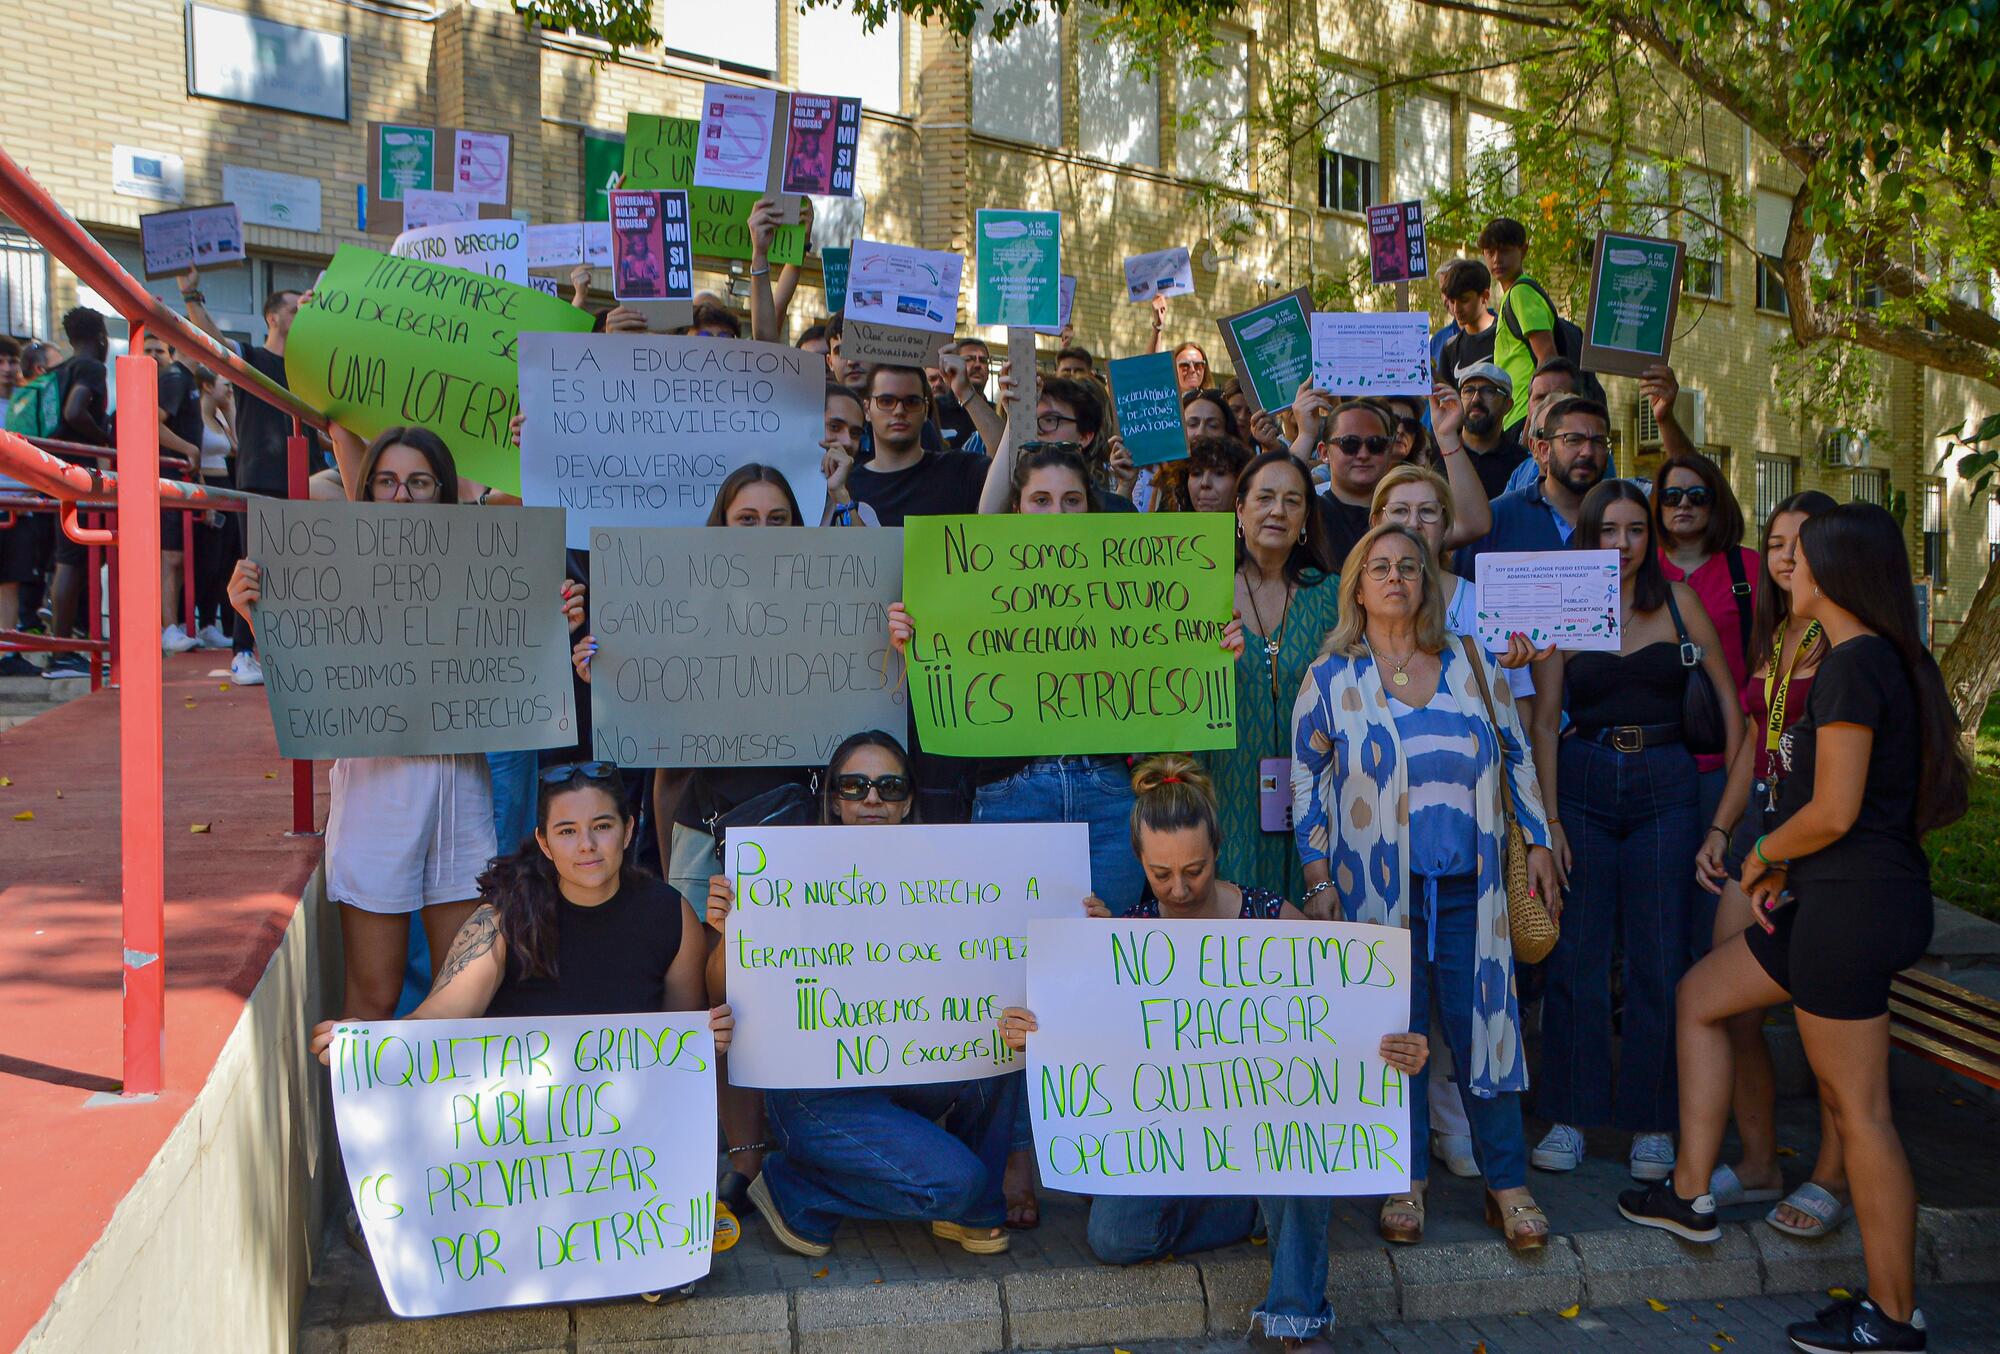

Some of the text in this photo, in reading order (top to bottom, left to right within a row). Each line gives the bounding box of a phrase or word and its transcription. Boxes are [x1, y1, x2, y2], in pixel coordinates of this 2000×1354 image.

[794, 108, 815, 118] AULAS
[795, 97, 831, 109] QUEREMOS
[841, 104, 855, 121] DI
[793, 118, 823, 129] EXCUSAS
[837, 127, 855, 145] MI
[838, 148, 851, 166] SI
[833, 167, 852, 189] ÓN
[615, 195, 653, 206] QUEREMOS
[615, 207, 638, 218] AULAS
[667, 200, 681, 218] DI
[708, 194, 734, 216] UN
[1407, 207, 1418, 220] DI
[616, 218, 648, 229] EXCUSAS
[666, 223, 685, 241] MI
[1028, 229, 1053, 237] JUNIO
[1407, 224, 1422, 238] MI
[454, 233, 519, 255] DERECHO
[670, 247, 685, 265] SI
[1411, 242, 1420, 254] SI
[669, 266, 689, 289] ÓN
[1410, 257, 1424, 271] ÓN
[1647, 260, 1669, 268] JUNIO
[310, 289, 518, 362] NO DEBERÍA SE
[552, 348, 800, 376] LA EDUCACION
[327, 346, 387, 409] UNA
[552, 378, 774, 404] ES UN DERECHO
[554, 410, 780, 435] NO UN PRIVILEGIO
[555, 454, 726, 478] DEVOLVERNOS
[558, 484, 721, 510] NUESTRO FUT
[260, 508, 519, 557] NOS DIERON UN
[944, 523, 1217, 574] NO SOMOS RECORTES
[260, 562, 531, 602] INICIO PERO NOS
[688, 553, 750, 590] NOS
[772, 553, 877, 591] FALTAN
[991, 581, 1190, 614] SOMOS FUTURO
[262, 605, 542, 649] ROBARON EL FINAL
[599, 600, 711, 637] GANAS,
[726, 601, 788, 638] NOS
[910, 628, 952, 662] LA
[967, 614, 1097, 656] CANCELACIÓN
[1110, 625, 1138, 650] NO
[1142, 623, 1169, 647] ES
[325, 661, 417, 690] PEDIMOS
[431, 656, 537, 687] FAVORES,
[1037, 666, 1233, 729] RETROCESO!!!
[288, 704, 408, 738] EXIGIMOS
[597, 726, 638, 765] NO
[680, 733, 797, 763] PROMESAS
[736, 841, 794, 911] POR
[900, 879, 1001, 907] DERECHO
[1026, 876, 1040, 901] A
[866, 941, 891, 963] LO
[898, 942, 942, 964] QUE
[959, 935, 1028, 961] EMPEZ
[1112, 930, 1395, 988] NO ELEGIMOS
[942, 994, 1003, 1024] AULAS
[1140, 995, 1337, 1051] FRACASAR
[574, 1027, 707, 1073] GRADOS
[836, 1034, 890, 1080] NO
[1042, 1057, 1403, 1120] NOS QUITARON LA
[452, 1080, 621, 1150] PÚBLICOS
[1049, 1120, 1405, 1176] OPCIÓN DE AVANZAR
[359, 1146, 657, 1220] ES PRIVATIZAR
[432, 1229, 506, 1285] POR
